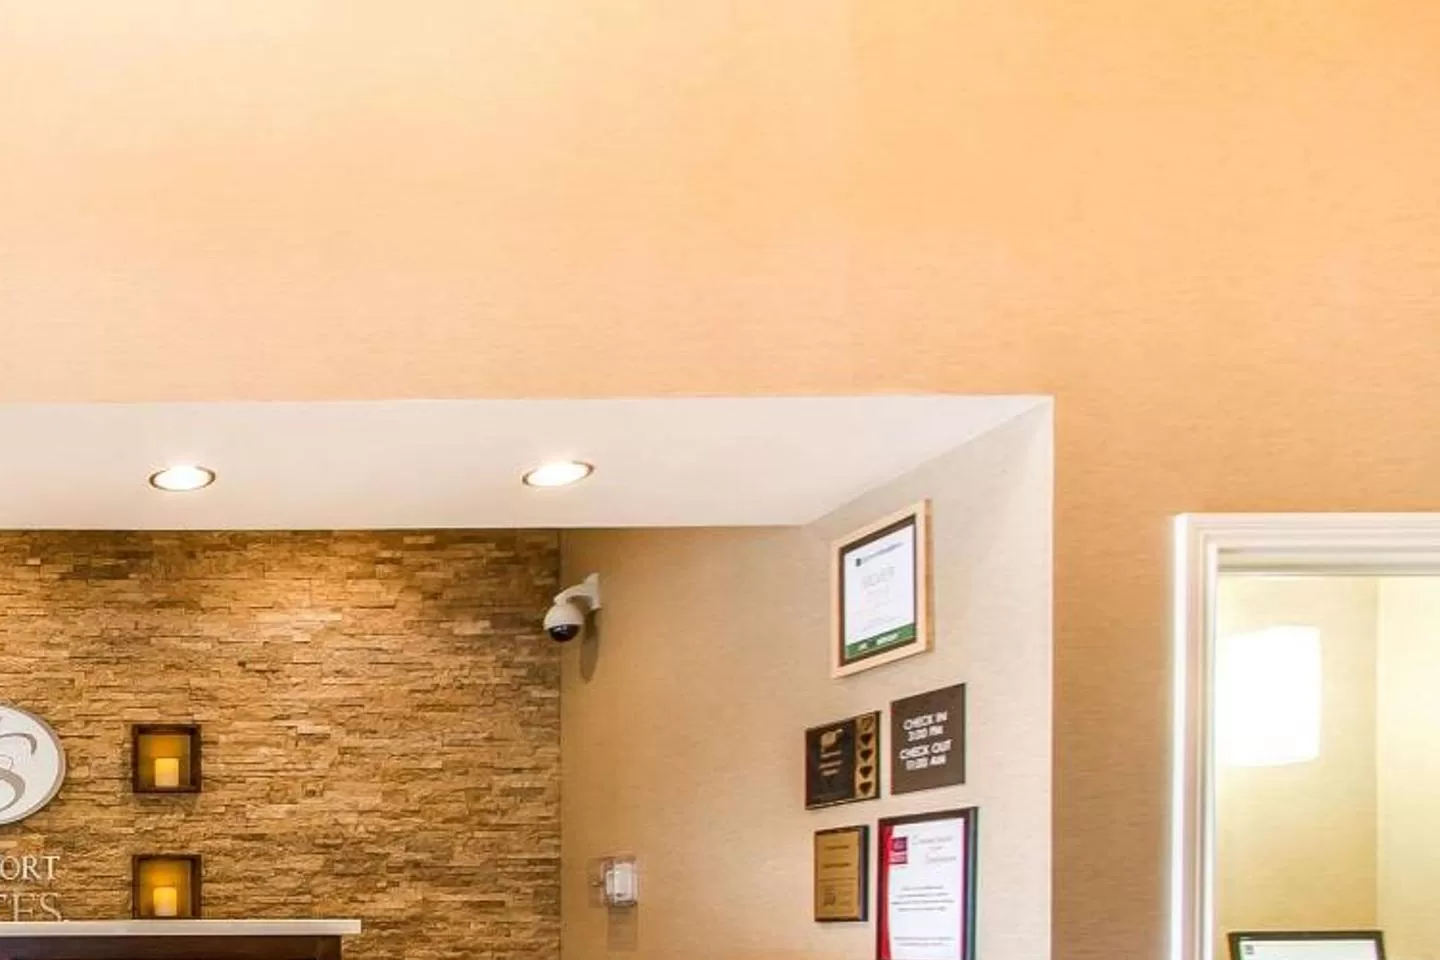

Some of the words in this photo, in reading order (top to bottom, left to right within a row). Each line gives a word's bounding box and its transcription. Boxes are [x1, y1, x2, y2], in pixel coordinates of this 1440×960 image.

[903, 714, 933, 730] CHECK
[899, 744, 930, 759] CHECK
[931, 739, 953, 754] OUT
